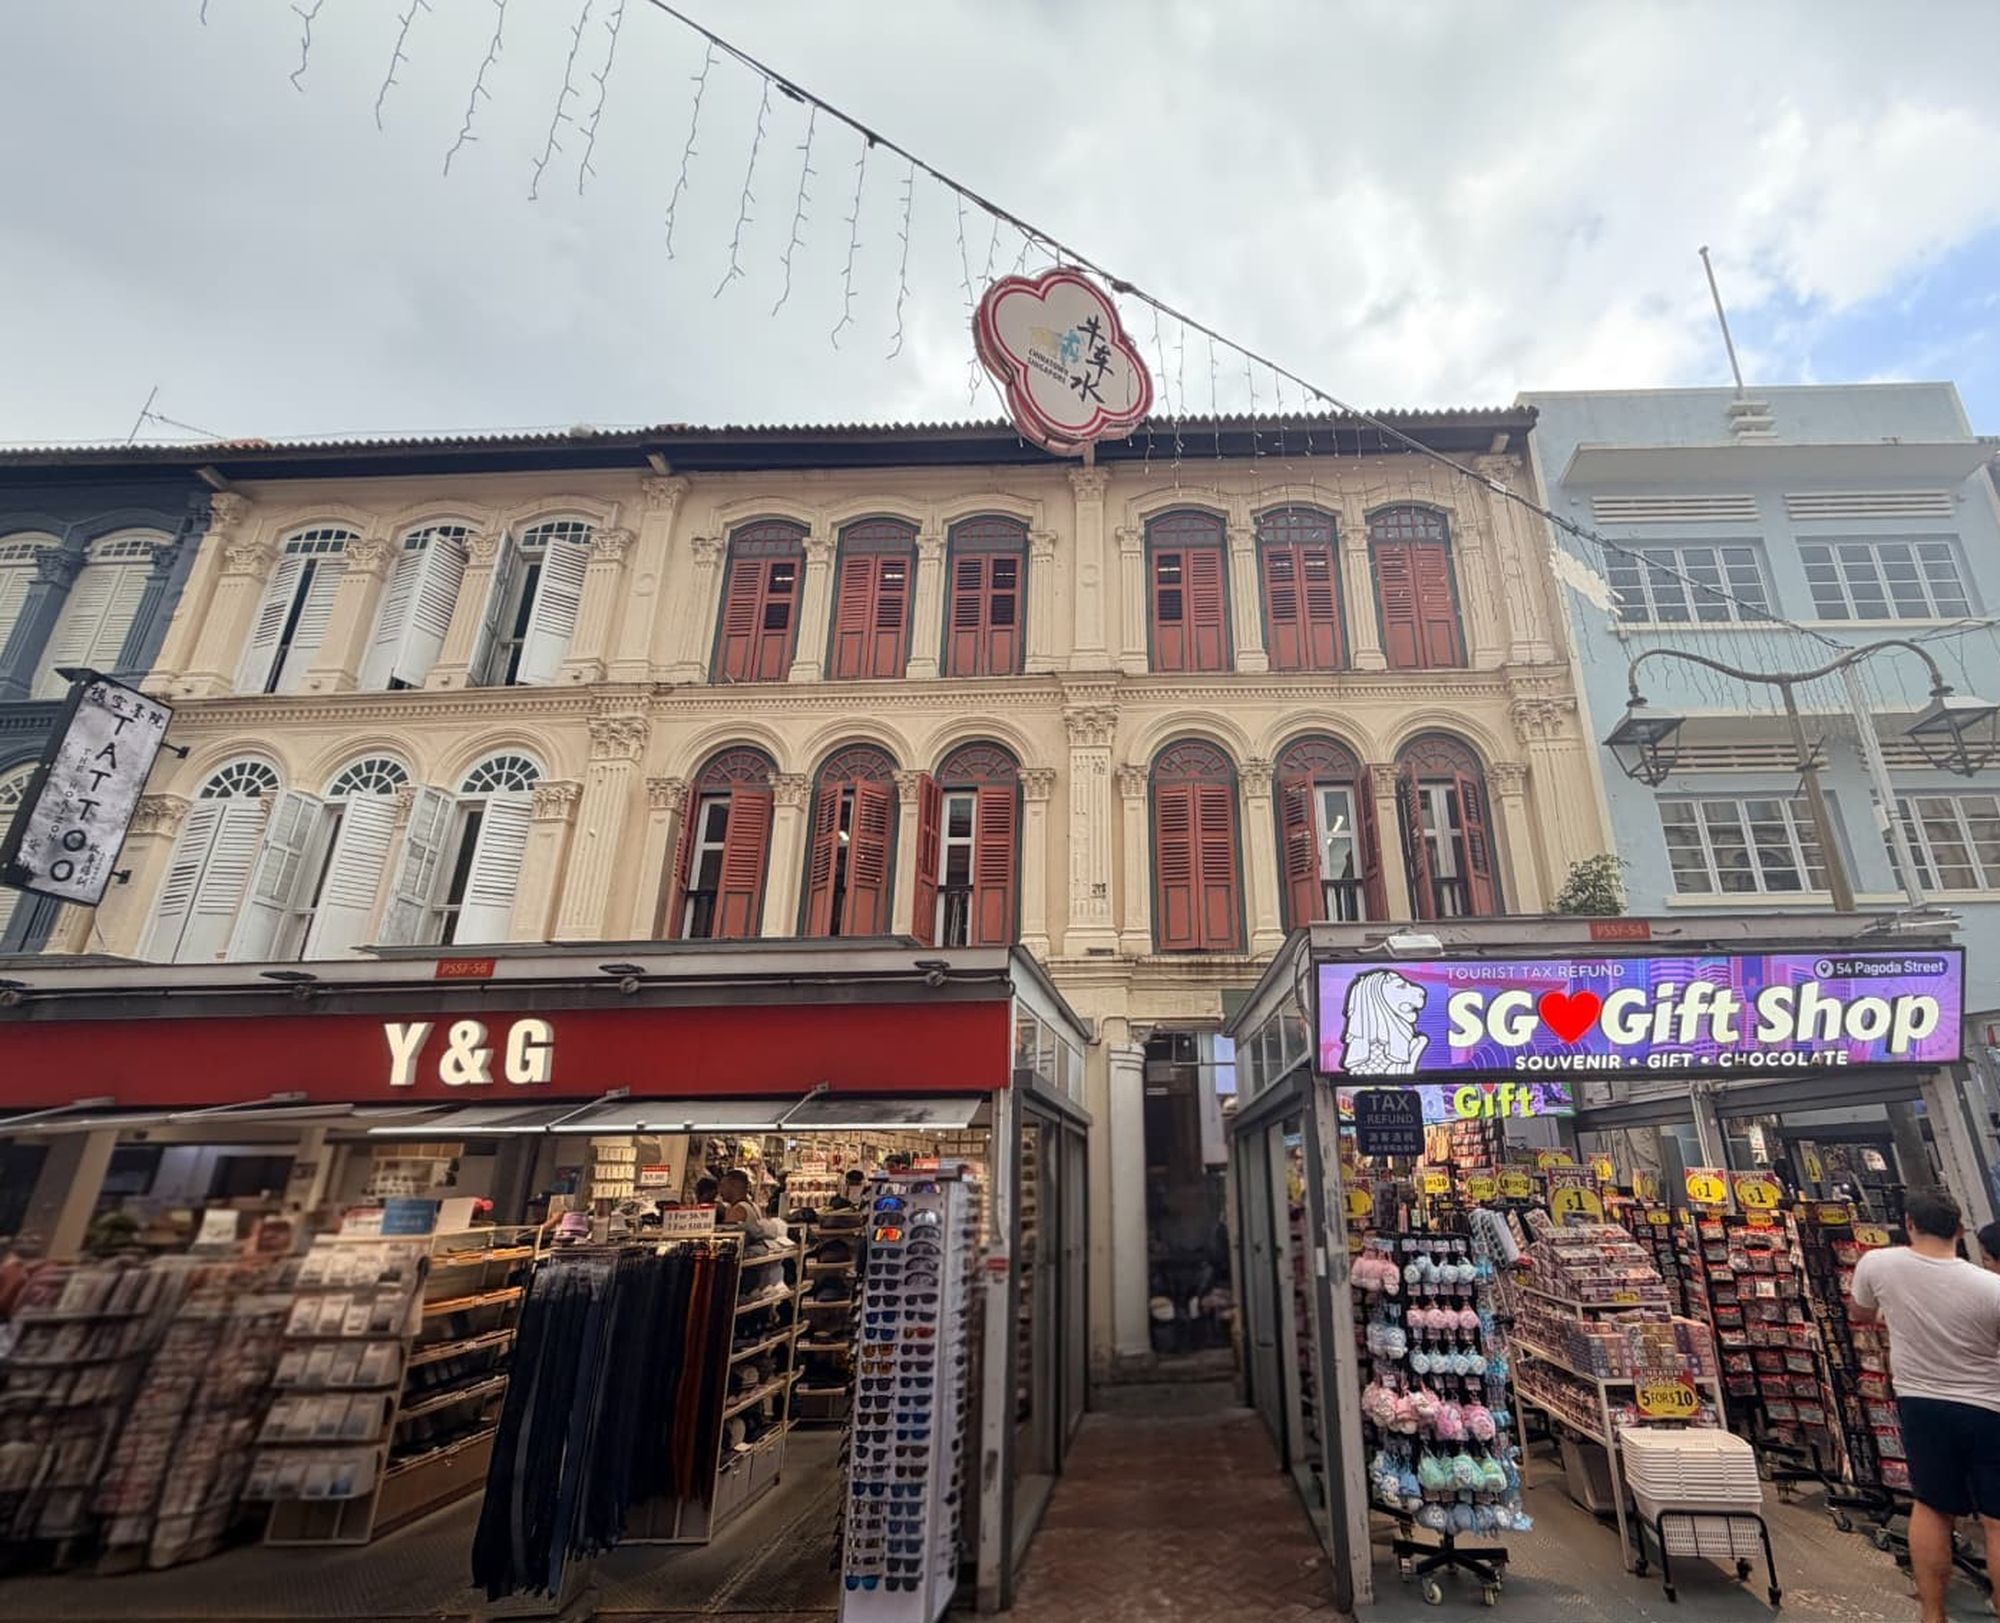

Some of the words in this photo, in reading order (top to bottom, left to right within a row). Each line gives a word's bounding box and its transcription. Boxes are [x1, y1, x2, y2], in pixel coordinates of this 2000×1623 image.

[50, 712, 135, 882] TATTOO
[1446, 966, 1514, 980] TOURIST
[1521, 967, 1552, 979] TAX
[1558, 964, 1625, 978] REFUND
[1836, 961, 1852, 975] 54
[1855, 961, 1902, 976] Pagoda
[1904, 960, 1944, 974] Street
[1447, 989, 1539, 1048] SG
[1601, 981, 1741, 1045] Gift
[1757, 980, 1940, 1054] Shop
[384, 1022, 434, 1086] Y
[438, 1019, 494, 1086] &
[504, 1018, 555, 1085] G
[1514, 1054, 1621, 1070] SOUVENIR
[1647, 1052, 1693, 1068] GIFT
[1718, 1050, 1849, 1068] CHOCOLATE
[1367, 1093, 1411, 1112] TAX
[1453, 1082, 1536, 1118] Gift
[1366, 1113, 1414, 1125] REFUND
[1553, 1174, 1595, 1190] SALE
[1696, 1181, 1713, 1198] $1
[1566, 1190, 1587, 1211] $1
[1748, 1186, 1767, 1204] $1
